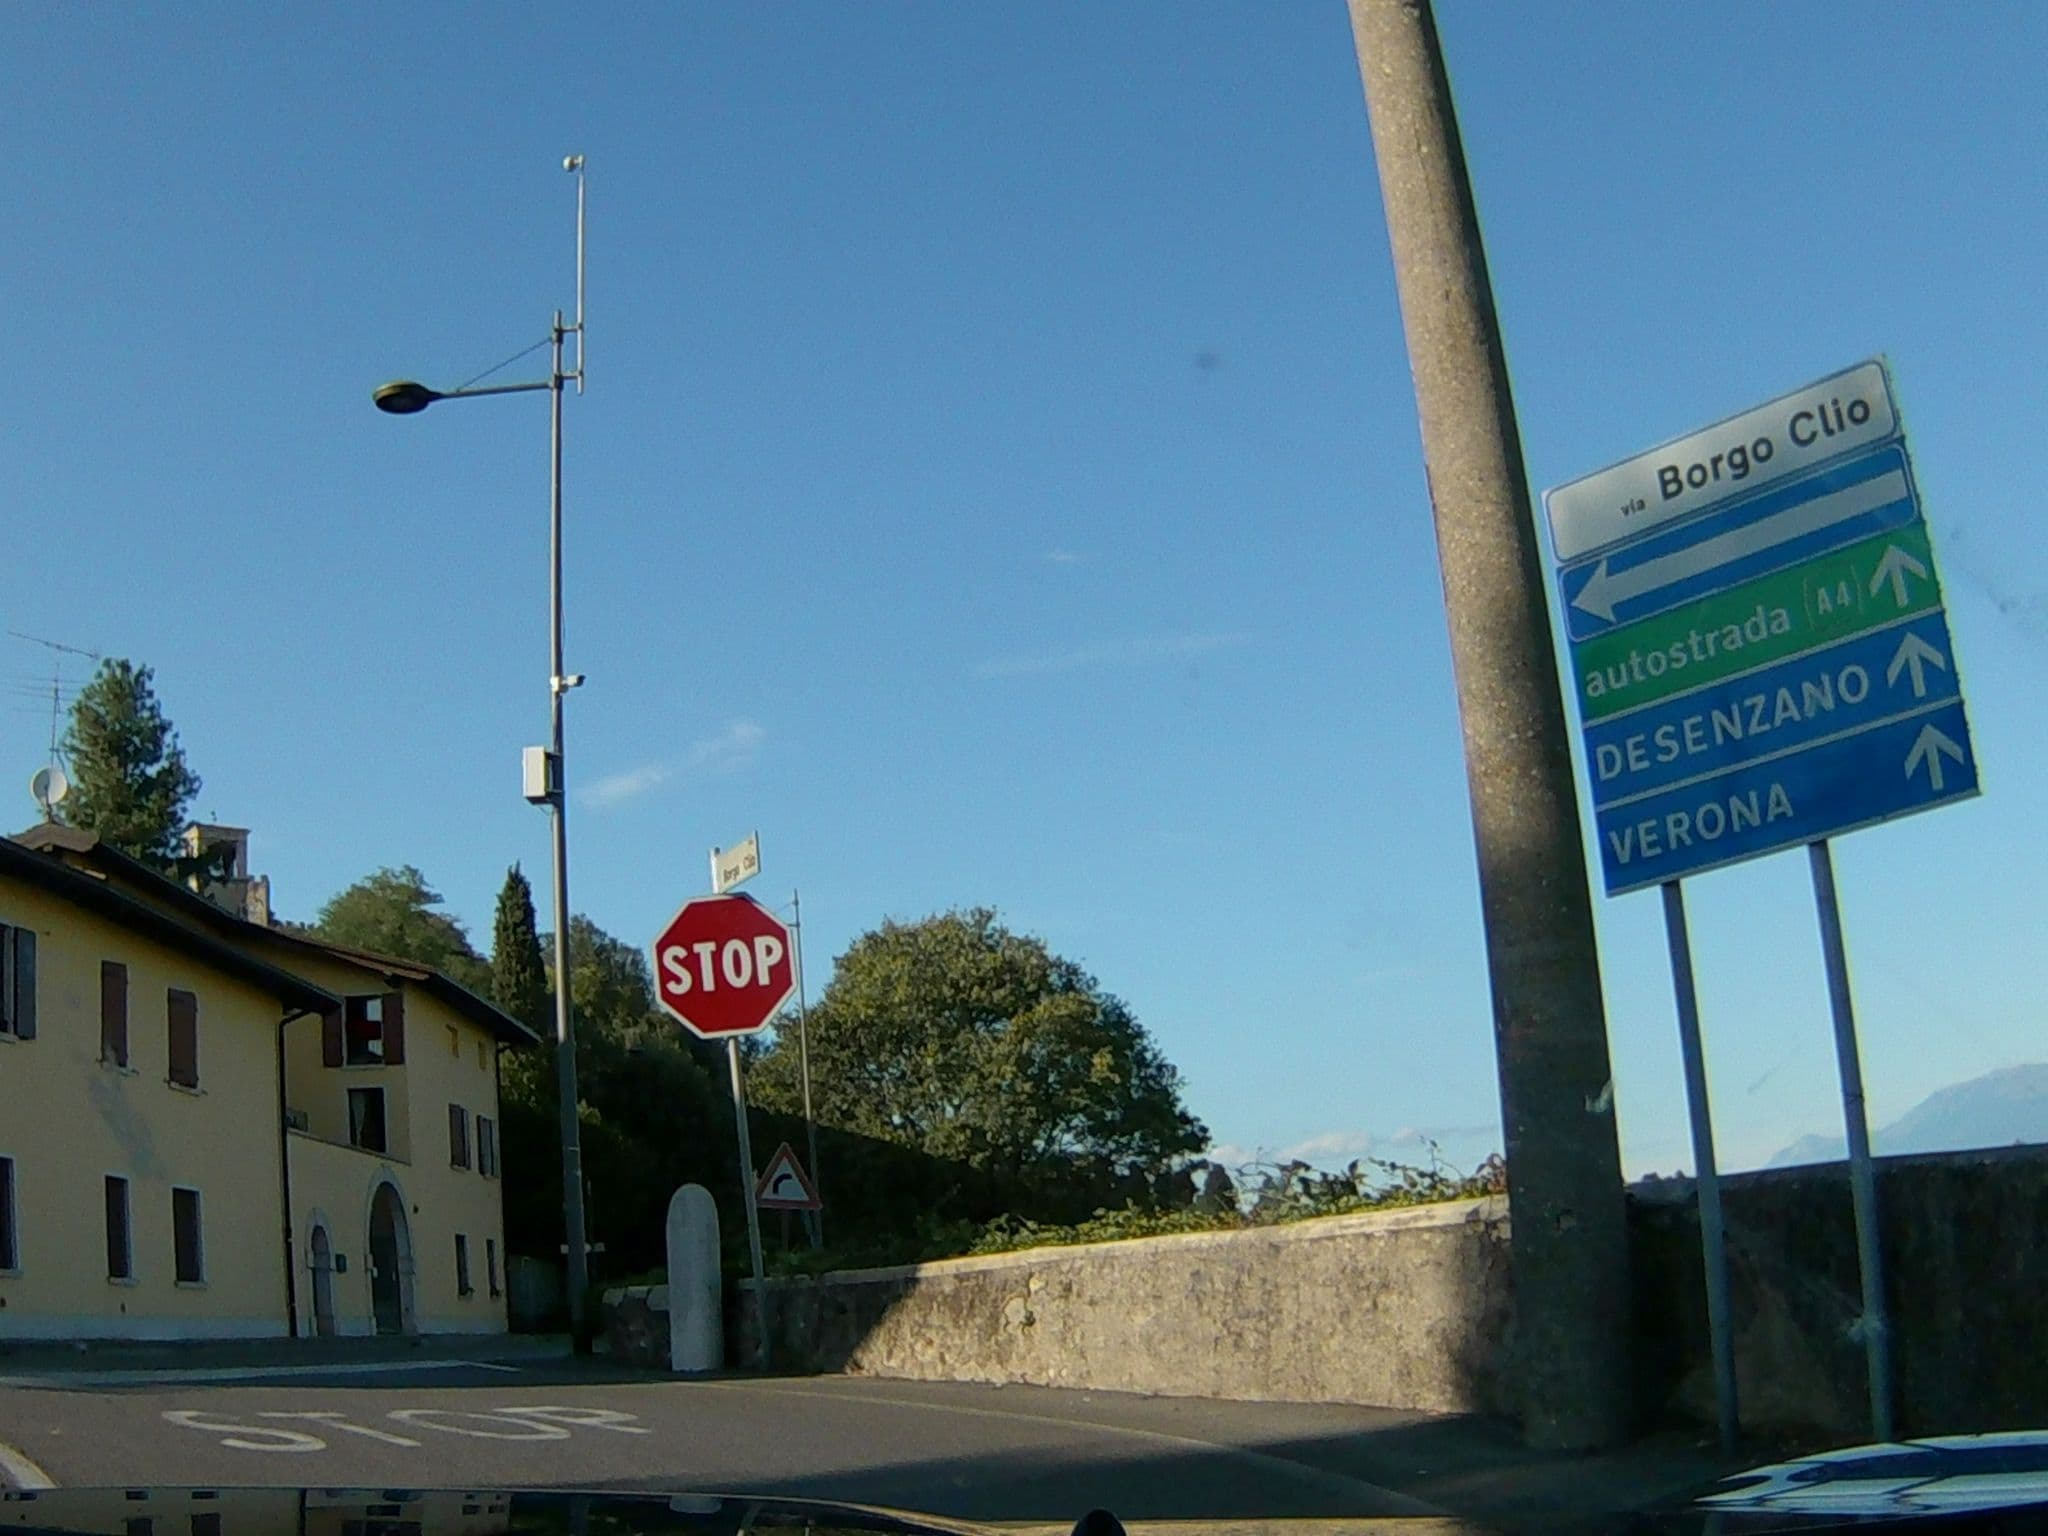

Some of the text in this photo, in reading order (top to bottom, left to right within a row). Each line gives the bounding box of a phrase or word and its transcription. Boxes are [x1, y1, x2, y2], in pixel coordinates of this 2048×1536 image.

[1621, 396, 1871, 517] via Borgo Clio
[1585, 603, 1791, 698] autostrada
[1596, 665, 1868, 782] DESENZANO
[1609, 784, 1793, 865] VERONA
[663, 936, 783, 995] STOP
[162, 1407, 652, 1453] STOP
